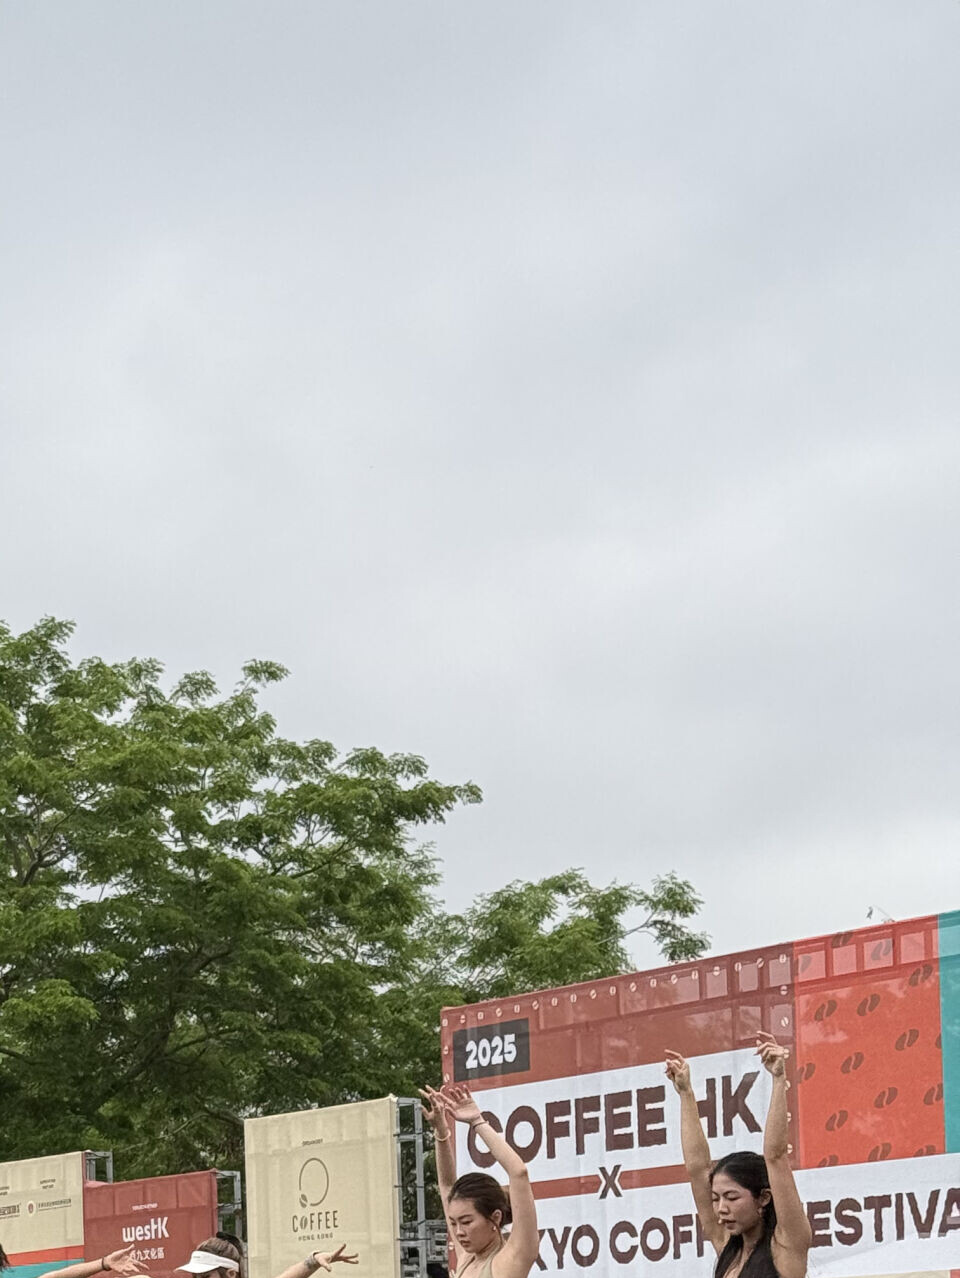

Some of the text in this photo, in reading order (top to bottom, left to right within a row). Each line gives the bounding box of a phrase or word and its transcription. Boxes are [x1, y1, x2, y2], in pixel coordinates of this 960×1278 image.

[465, 1033, 518, 1069] 2025
[467, 1086, 667, 1168] COFFEE
[122, 1216, 170, 1243] westK
[292, 1210, 339, 1233] COFFEE
